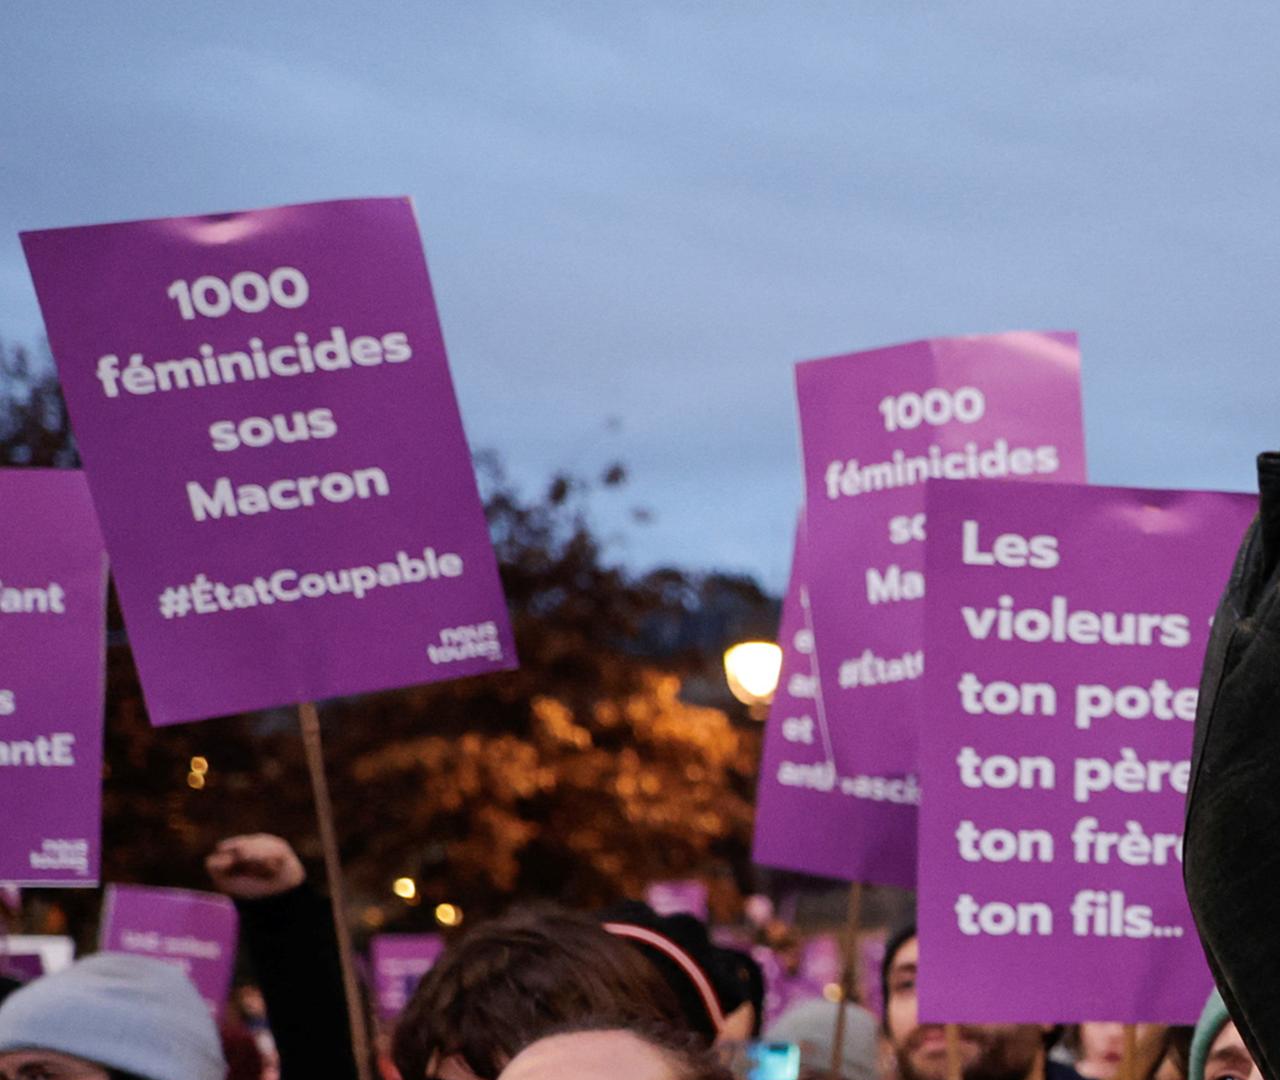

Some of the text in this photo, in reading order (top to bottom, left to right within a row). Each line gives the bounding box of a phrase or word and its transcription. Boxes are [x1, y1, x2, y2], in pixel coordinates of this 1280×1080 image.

[167, 266, 309, 320] 1000
[96, 325, 412, 398] féminicides
[209, 408, 338, 452] sous
[879, 385, 986, 432] 1000
[824, 437, 1060, 500] féminicides
[186, 467, 390, 522] Macron
[962, 520, 1060, 569] Les
[0, 581, 65, 614] ant
[158, 547, 464, 619] #ÉtatCoupable
[866, 564, 925, 604] Ma
[961, 595, 1191, 648] violeurs
[838, 649, 924, 689] #État
[957, 672, 1057, 716] ton
[956, 746, 1055, 789] ton
[955, 820, 1054, 862] ton
[954, 894, 1053, 936] ton
